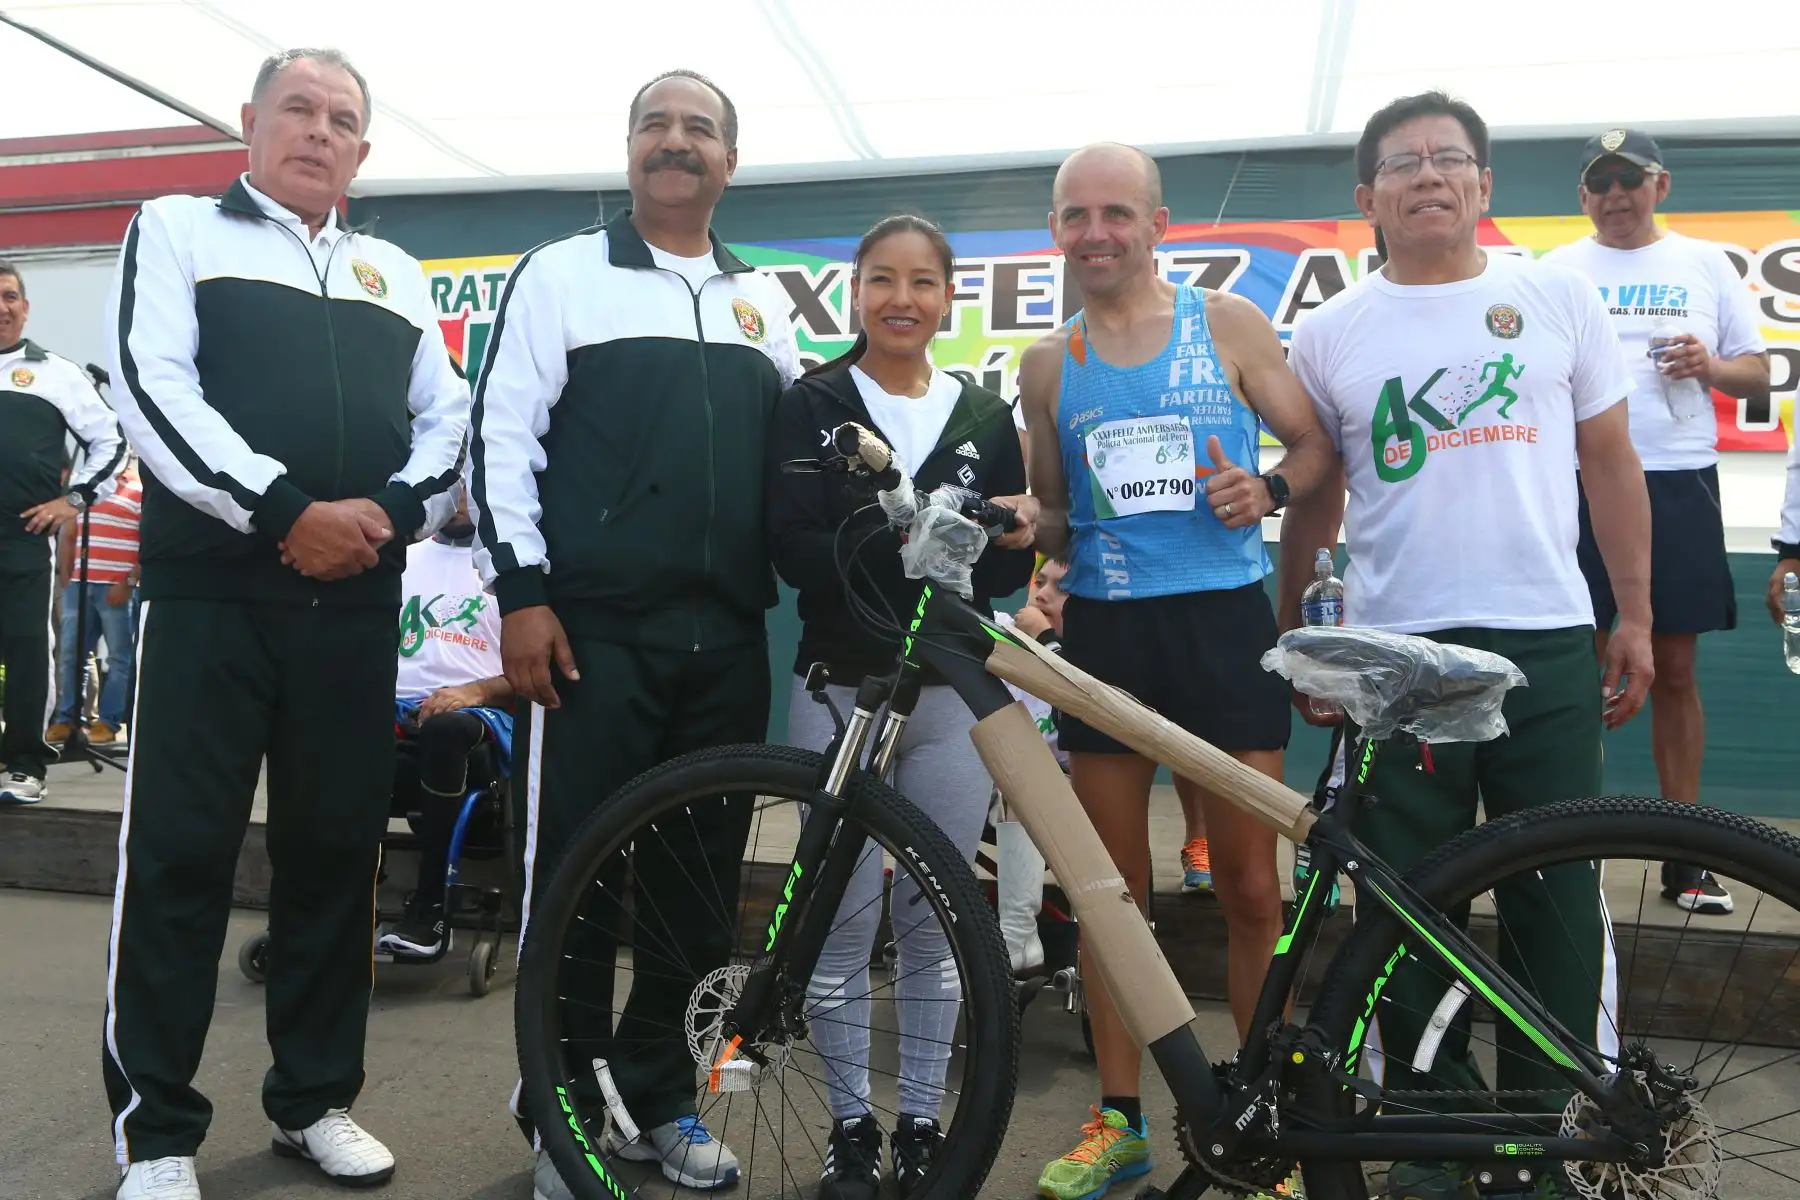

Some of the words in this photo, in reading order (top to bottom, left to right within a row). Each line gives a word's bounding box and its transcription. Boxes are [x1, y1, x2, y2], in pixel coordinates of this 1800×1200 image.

[1648, 307, 1689, 319] DECIDES
[1159, 388, 1232, 409] FARTLEK
[1190, 414, 1232, 426] RUNNING
[1113, 428, 1135, 438] FELIZ
[1123, 437, 1155, 446] Nacional
[1158, 434, 1169, 442] del
[1383, 442, 1411, 466] DE
[1426, 423, 1538, 454] DICIEMBRE
[955, 448, 981, 461] adidas
[1120, 478, 1194, 500] 002790
[404, 633, 416, 645] DE
[425, 629, 488, 651] DICIEMBRE
[904, 845, 958, 924] KENDA
